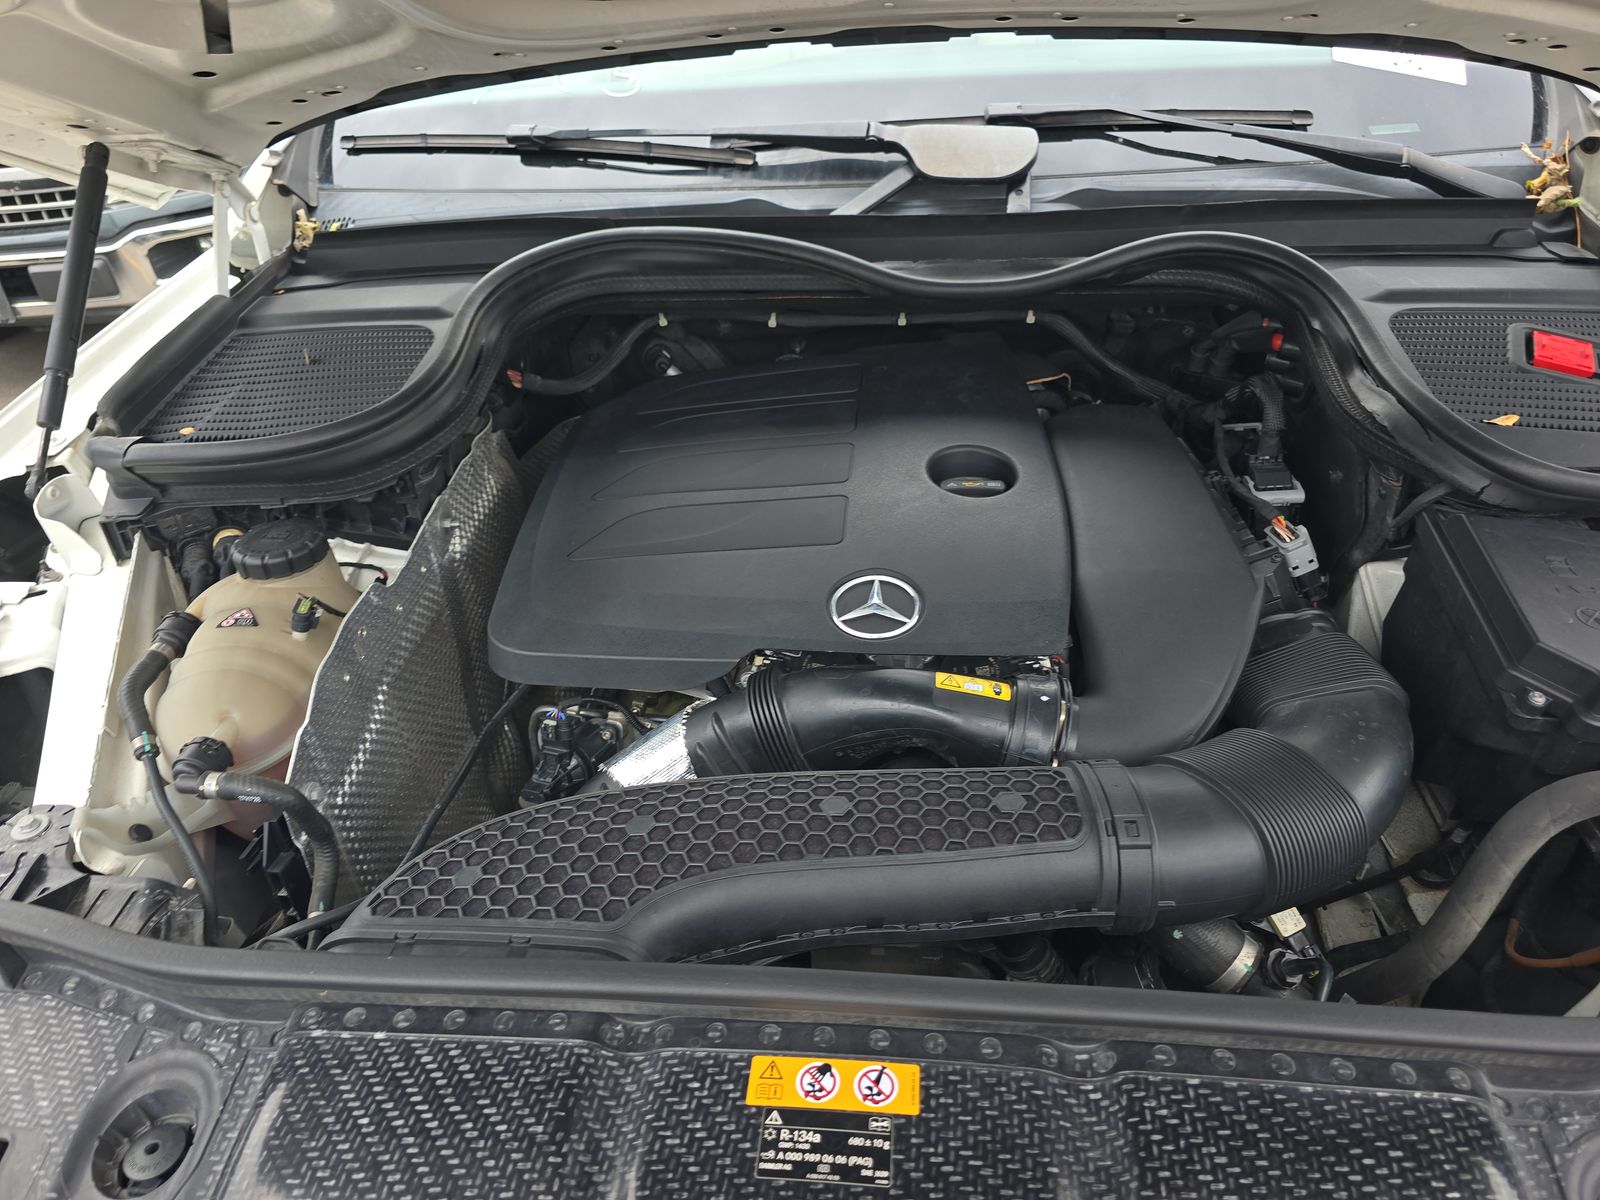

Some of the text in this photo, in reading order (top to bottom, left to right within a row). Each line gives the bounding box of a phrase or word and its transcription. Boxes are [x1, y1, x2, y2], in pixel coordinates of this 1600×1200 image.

[780, 1128, 822, 1143] R-134a
[776, 1151, 785, 1160] A
[784, 1151, 803, 1161] 000
[821, 1153, 834, 1164] 06
[834, 1154, 848, 1165] 06
